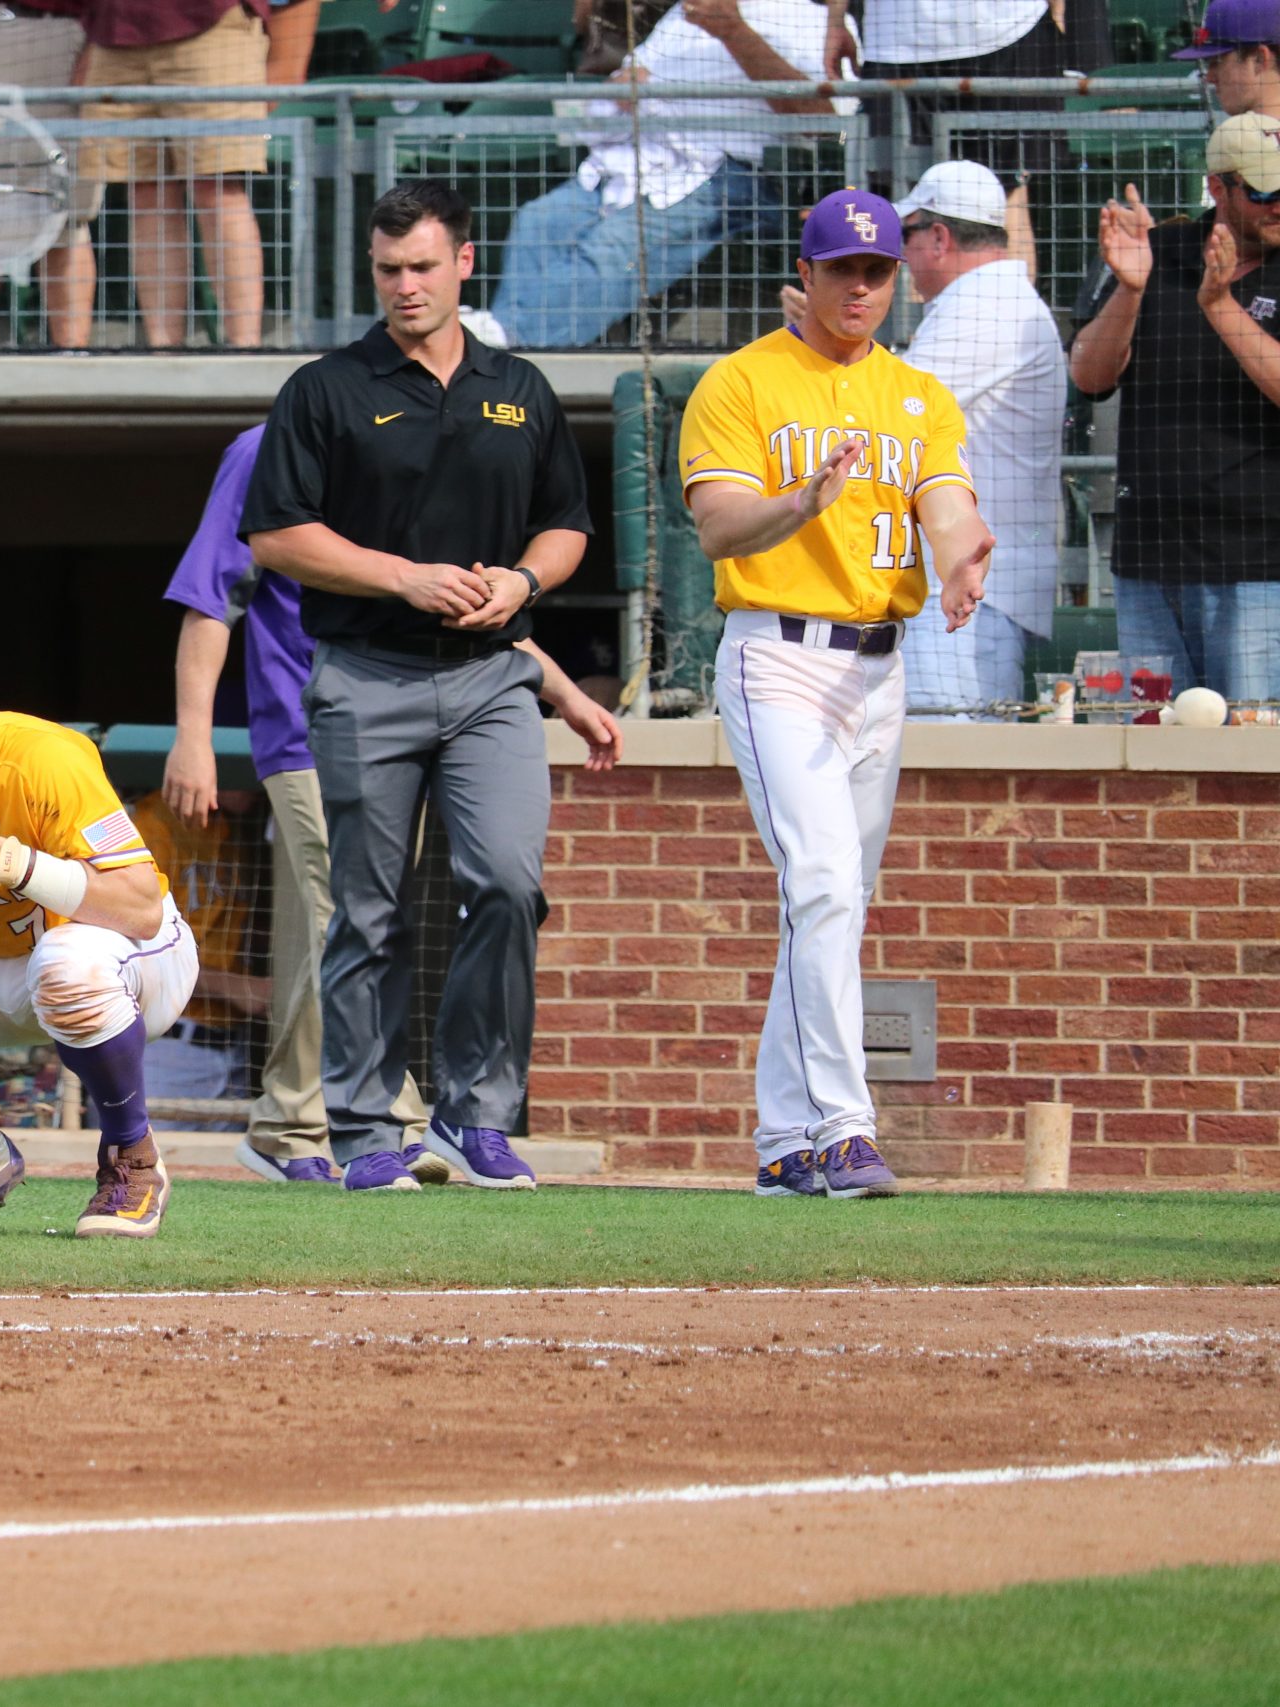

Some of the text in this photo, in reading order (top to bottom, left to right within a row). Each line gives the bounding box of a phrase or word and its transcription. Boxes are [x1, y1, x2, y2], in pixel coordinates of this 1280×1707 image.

[845, 203, 879, 243] LSU
[483, 401, 526, 422] LSU
[769, 421, 924, 498] TIGERS
[871, 512, 917, 569] 11
[7, 902, 47, 950] 7
